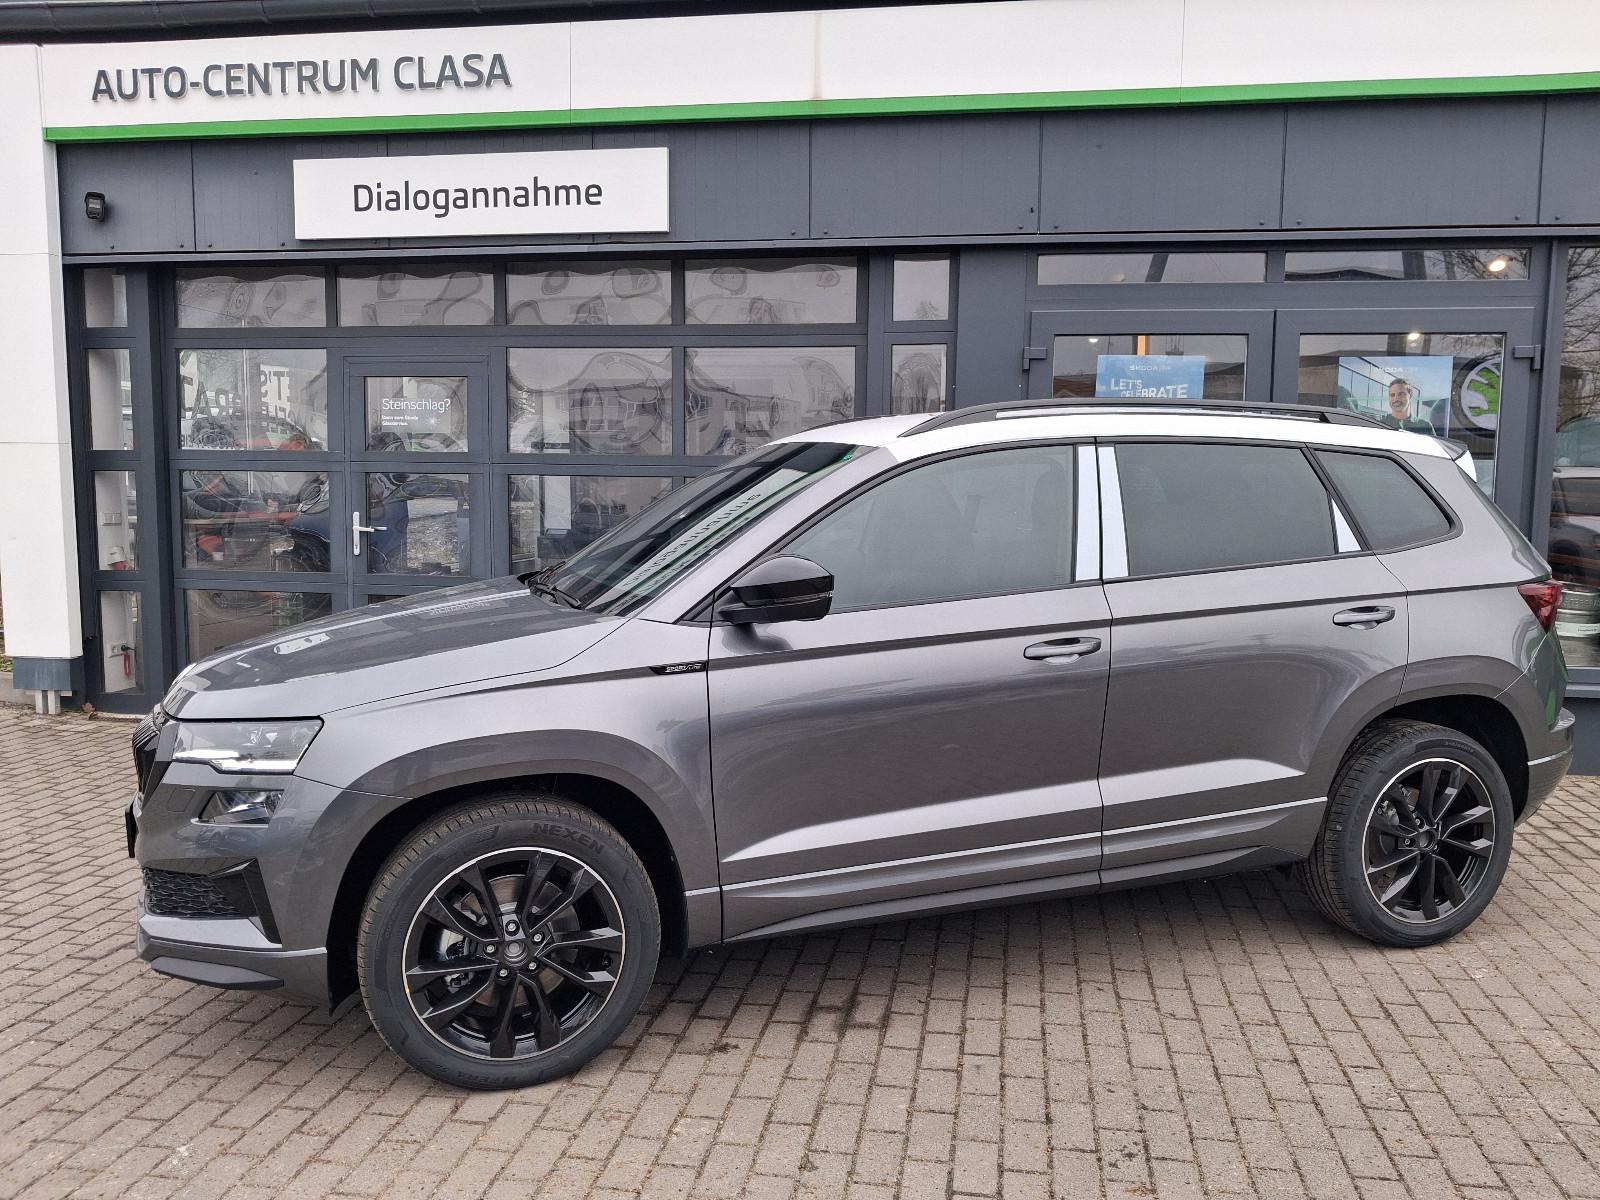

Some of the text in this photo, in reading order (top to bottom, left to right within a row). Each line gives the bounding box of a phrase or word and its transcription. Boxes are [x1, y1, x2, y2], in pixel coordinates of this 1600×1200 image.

[91, 53, 512, 103] AUTO-CENTRUM CLASA
[353, 175, 603, 219] Dialogannahme
[1110, 377, 1143, 391] LET'S
[382, 397, 452, 414] Steinschlag?
[531, 822, 605, 855] NEXEN
